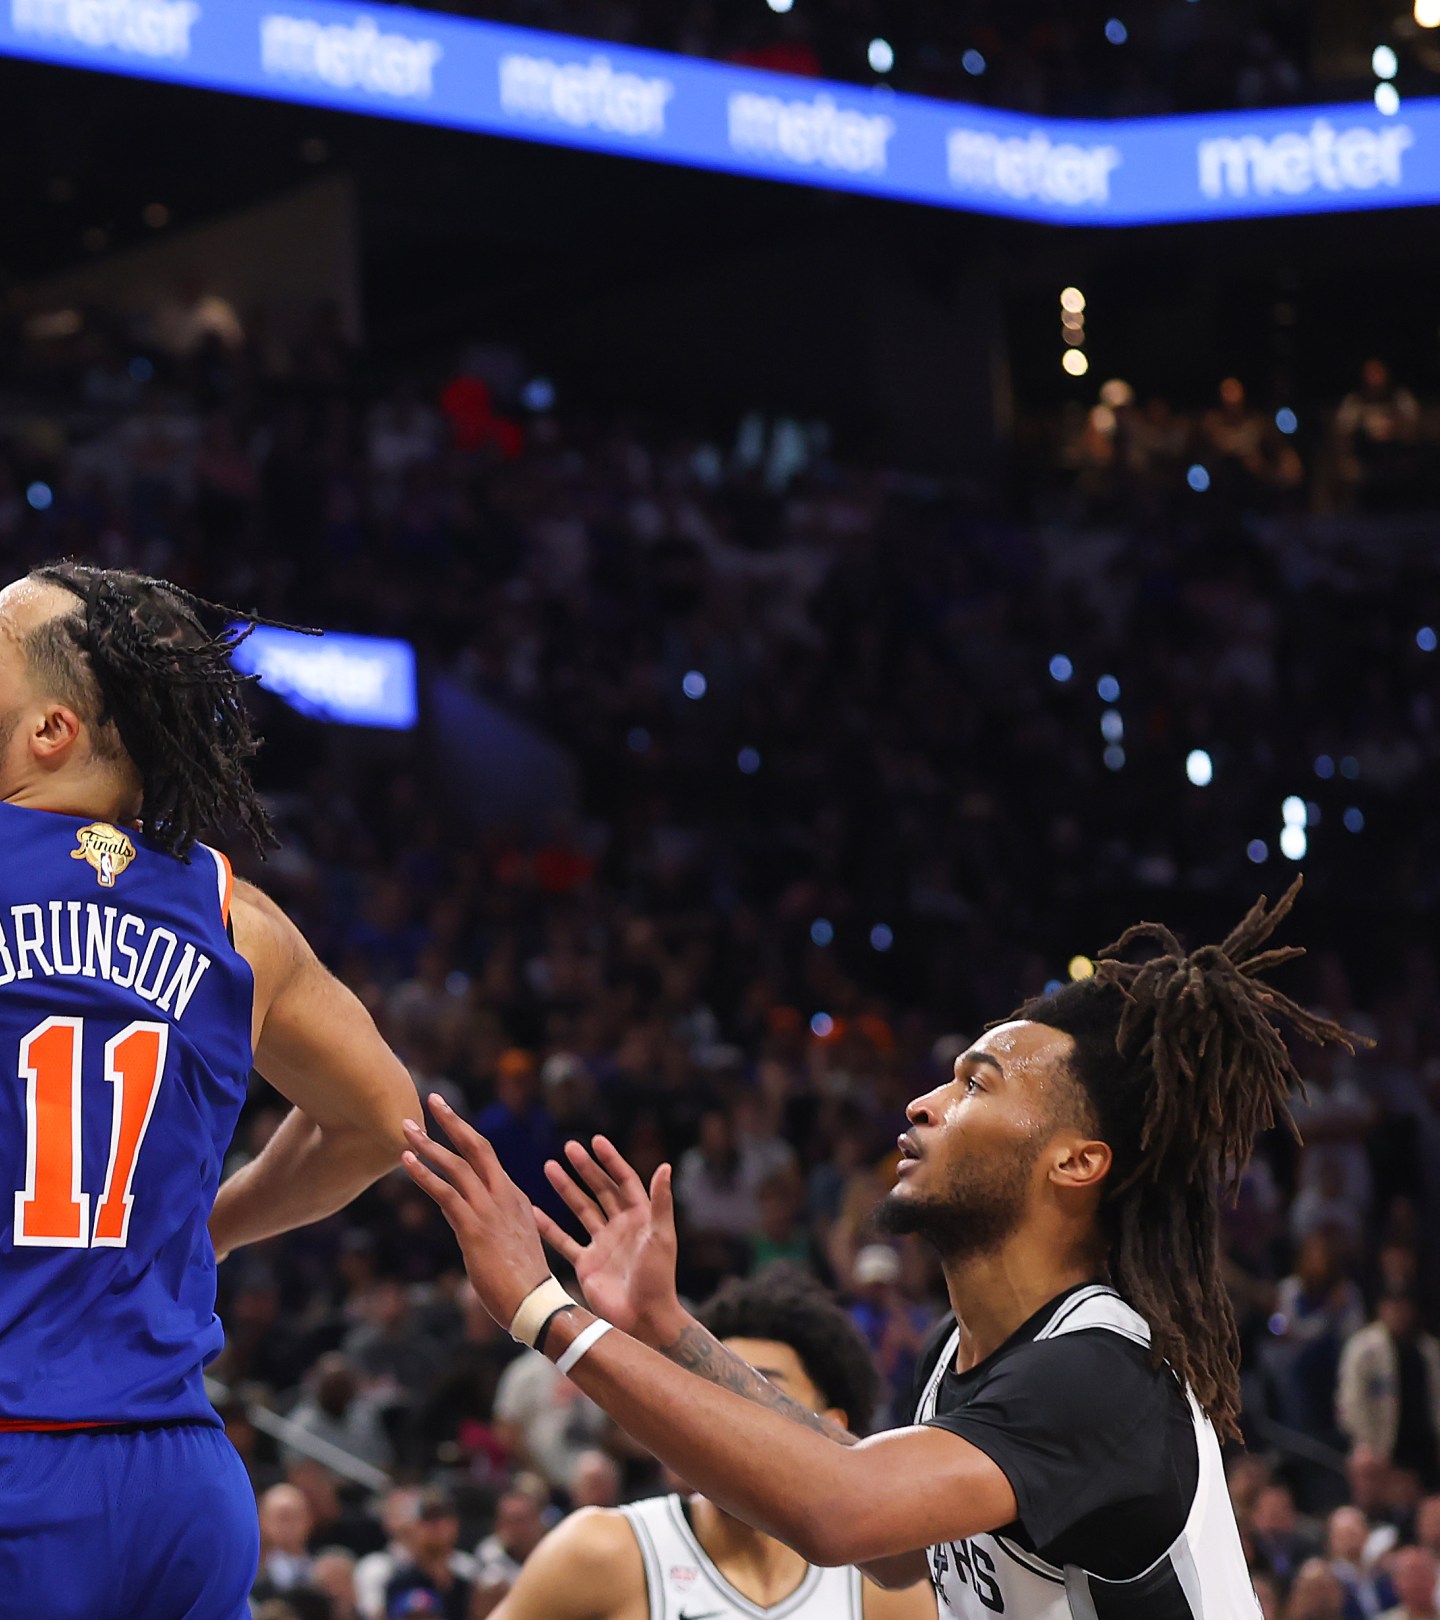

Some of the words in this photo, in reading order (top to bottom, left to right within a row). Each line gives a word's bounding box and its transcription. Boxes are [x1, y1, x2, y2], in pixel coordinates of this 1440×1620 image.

[262, 16, 442, 98] meter
[498, 55, 673, 138] meter
[727, 92, 895, 176] meter
[947, 129, 1122, 206] meter
[1198, 118, 1413, 197] meter
[76, 831, 133, 857] Finals
[13, 1015, 169, 1248] 11
